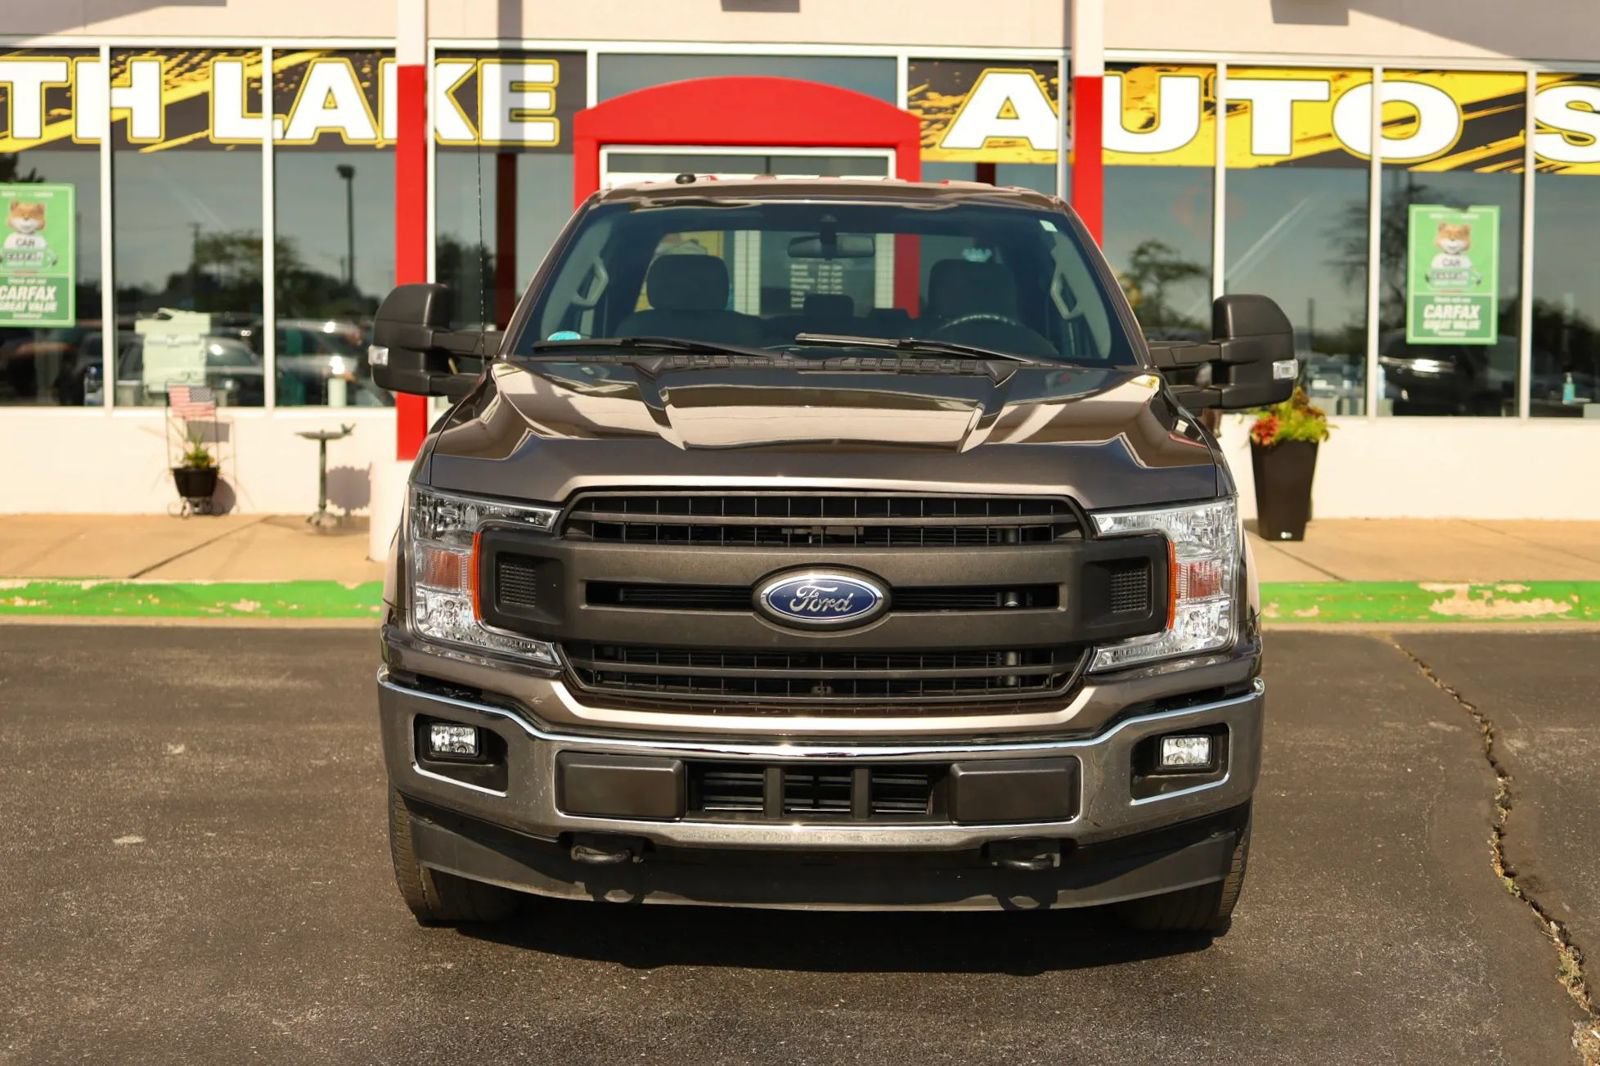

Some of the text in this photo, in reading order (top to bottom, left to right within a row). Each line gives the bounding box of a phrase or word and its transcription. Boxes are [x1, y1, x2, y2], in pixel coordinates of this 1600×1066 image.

[209, 57, 559, 146] LAKE
[939, 68, 1463, 162] AUTO
[0, 285, 57, 300] CARFAX
[1423, 304, 1481, 319] CARFAX
[789, 584, 854, 612] Ford
